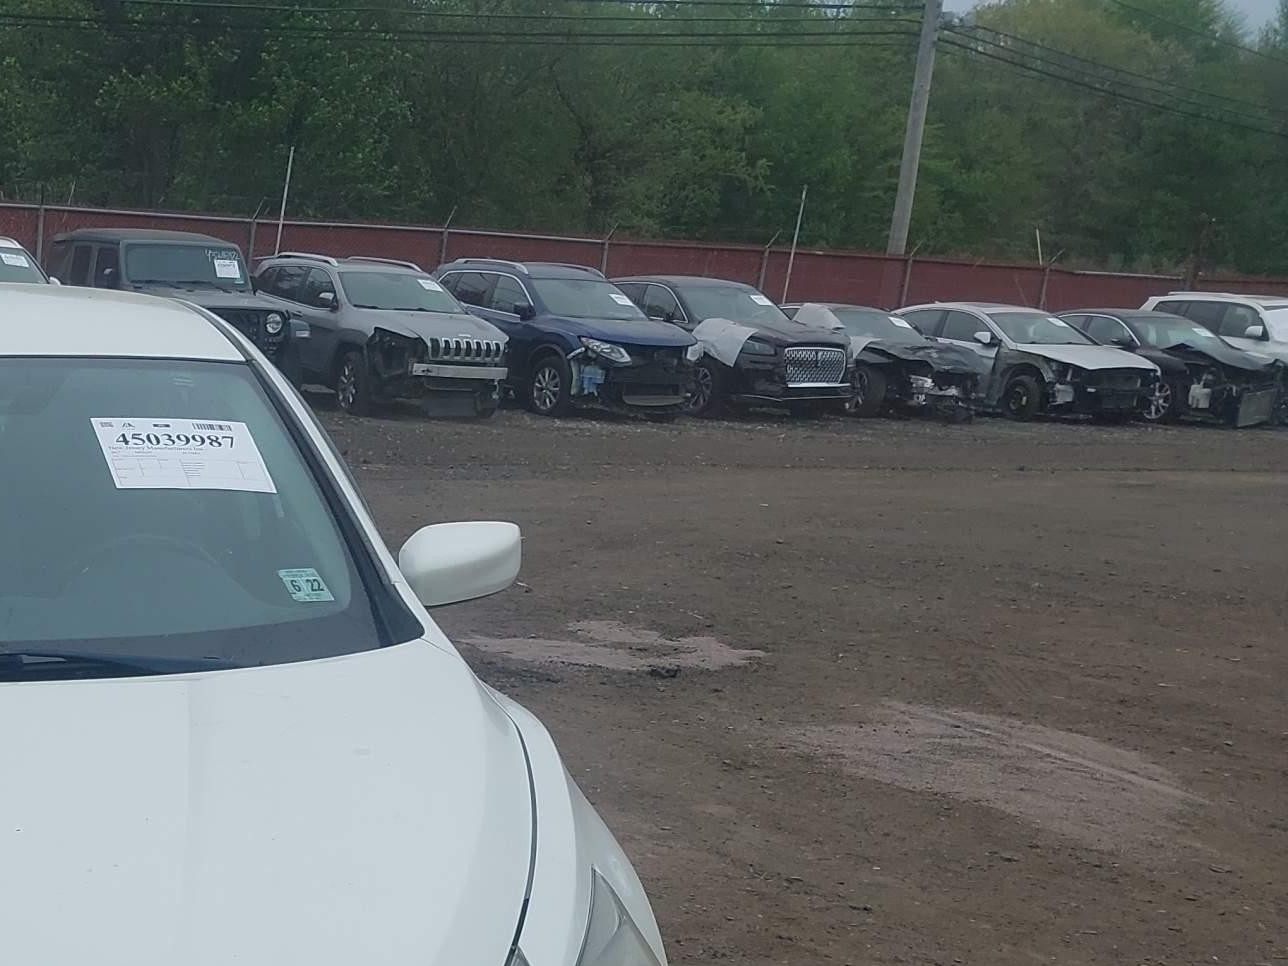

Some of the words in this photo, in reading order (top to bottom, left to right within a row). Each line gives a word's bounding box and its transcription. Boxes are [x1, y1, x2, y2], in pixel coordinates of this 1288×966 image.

[115, 432, 235, 449] 45039987
[290, 579, 302, 592] 6
[305, 578, 325, 592] 22
